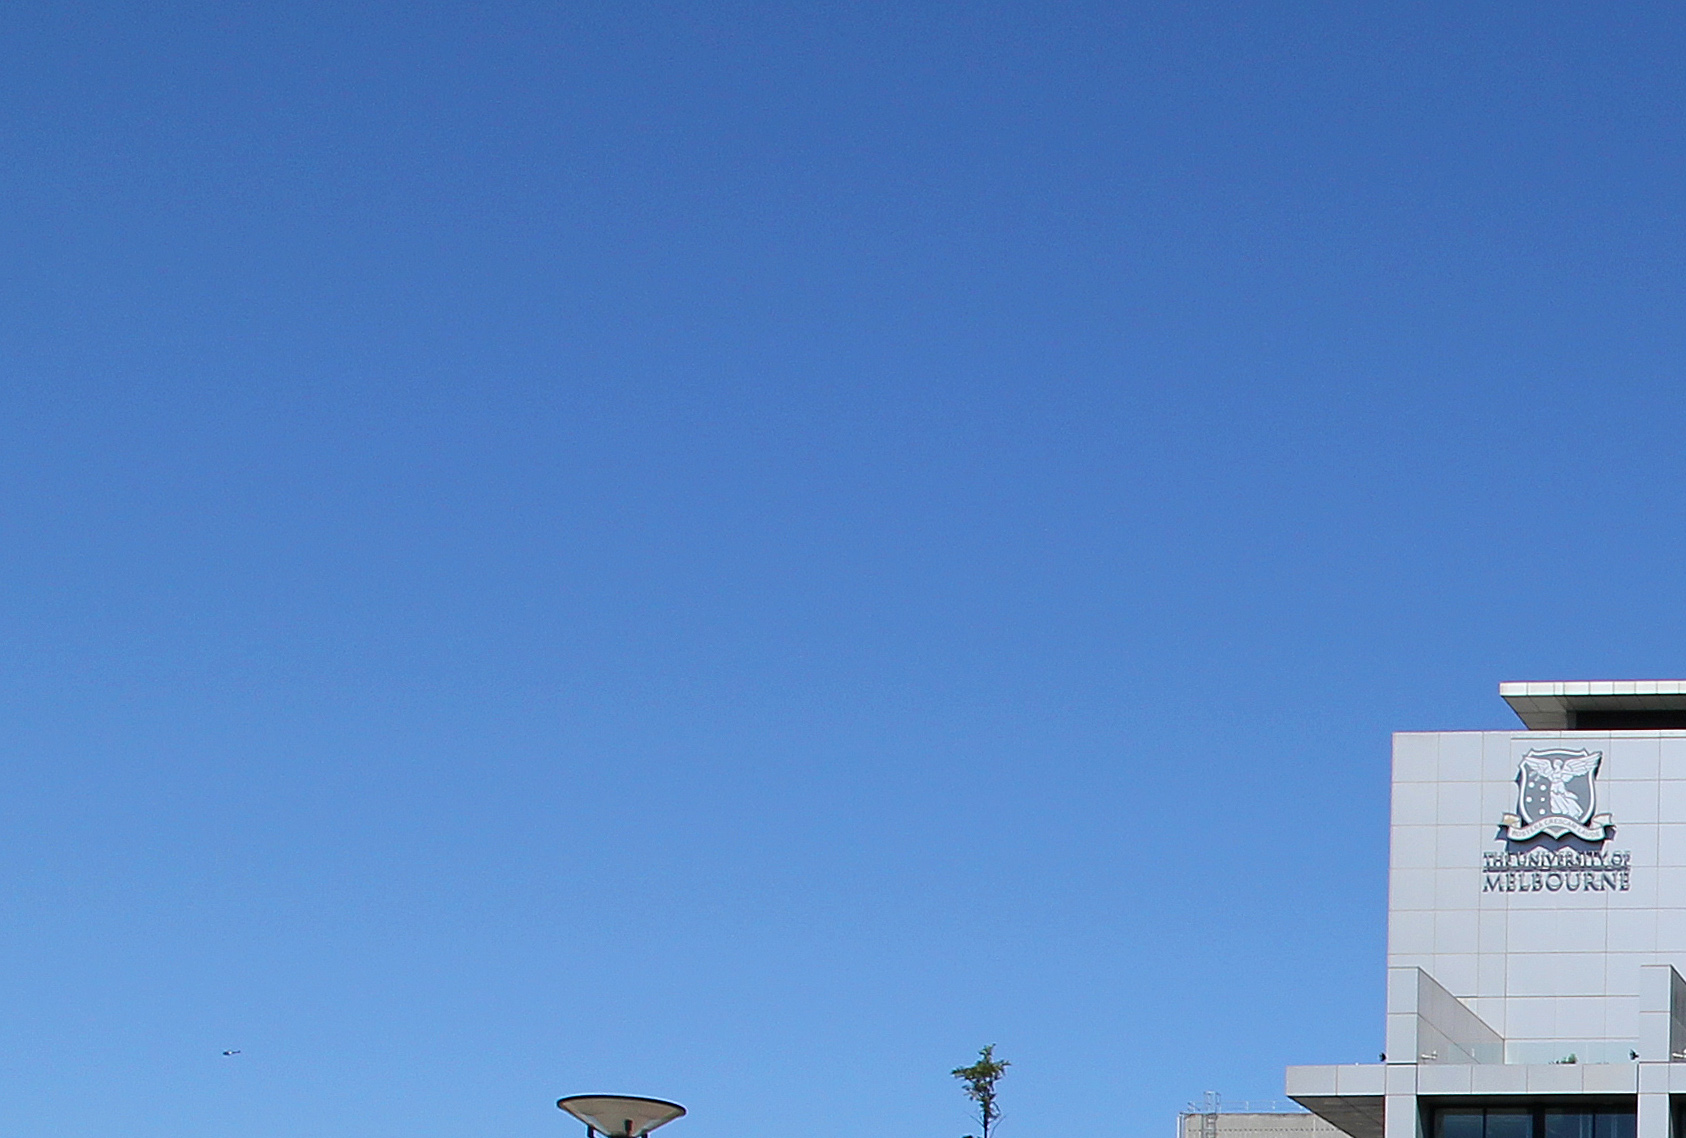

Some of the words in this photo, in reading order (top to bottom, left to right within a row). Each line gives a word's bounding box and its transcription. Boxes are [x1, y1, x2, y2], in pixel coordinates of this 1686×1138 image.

[1483, 851, 1509, 867] THE
[1516, 850, 1608, 867] UNIVERSITY
[1610, 850, 1631, 866] OF
[1483, 871, 1630, 892] MELBOURNE
